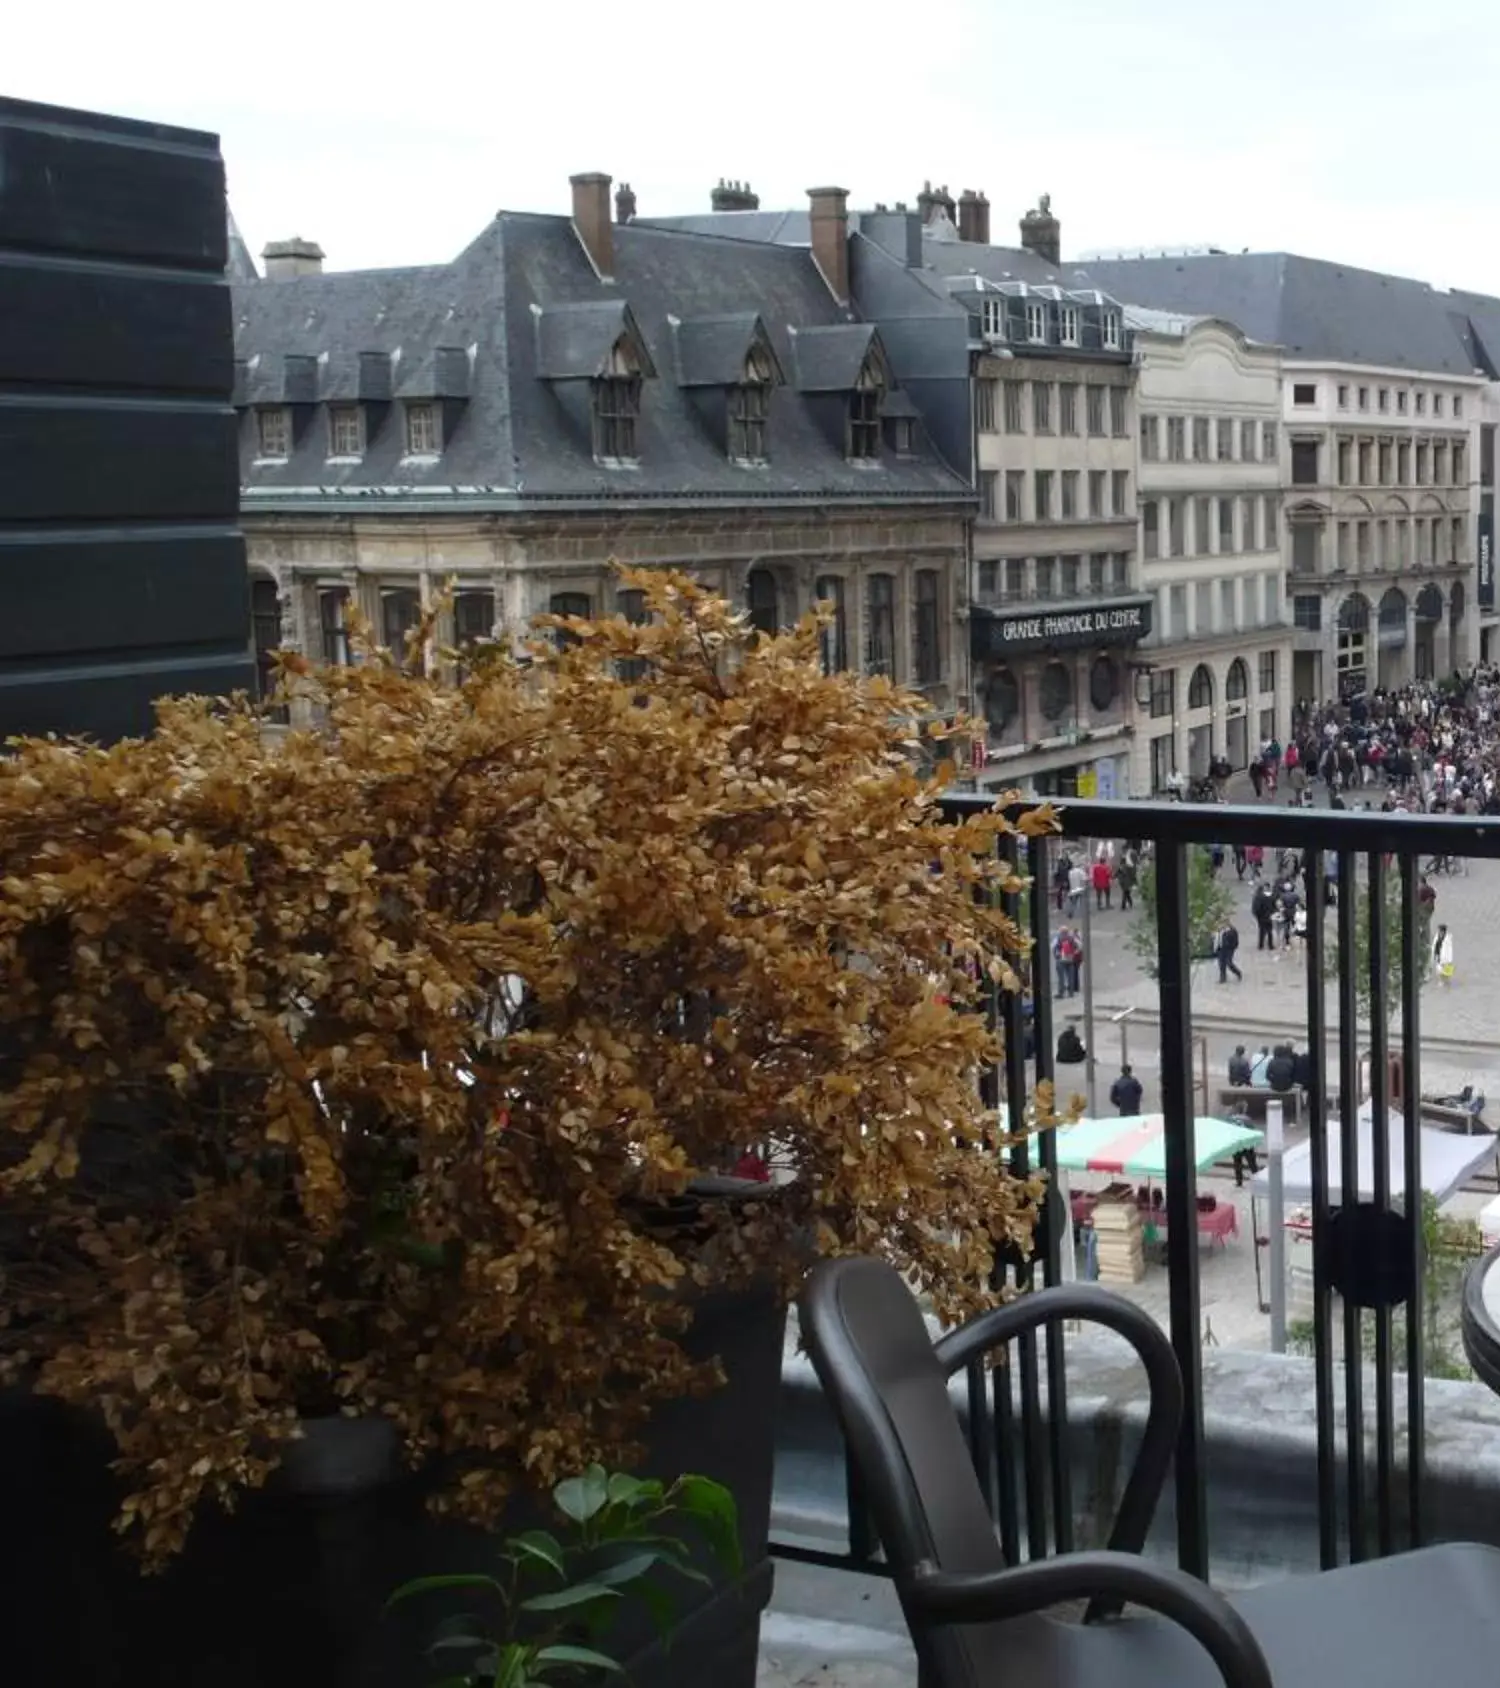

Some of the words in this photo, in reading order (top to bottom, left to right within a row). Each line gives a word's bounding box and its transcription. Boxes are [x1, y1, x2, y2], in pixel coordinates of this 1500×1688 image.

[1003, 619, 1043, 641] GRANDE
[1044, 613, 1093, 636] PHARMACIE
[1096, 611, 1108, 632] DU
[1109, 608, 1141, 628] CENTRE
